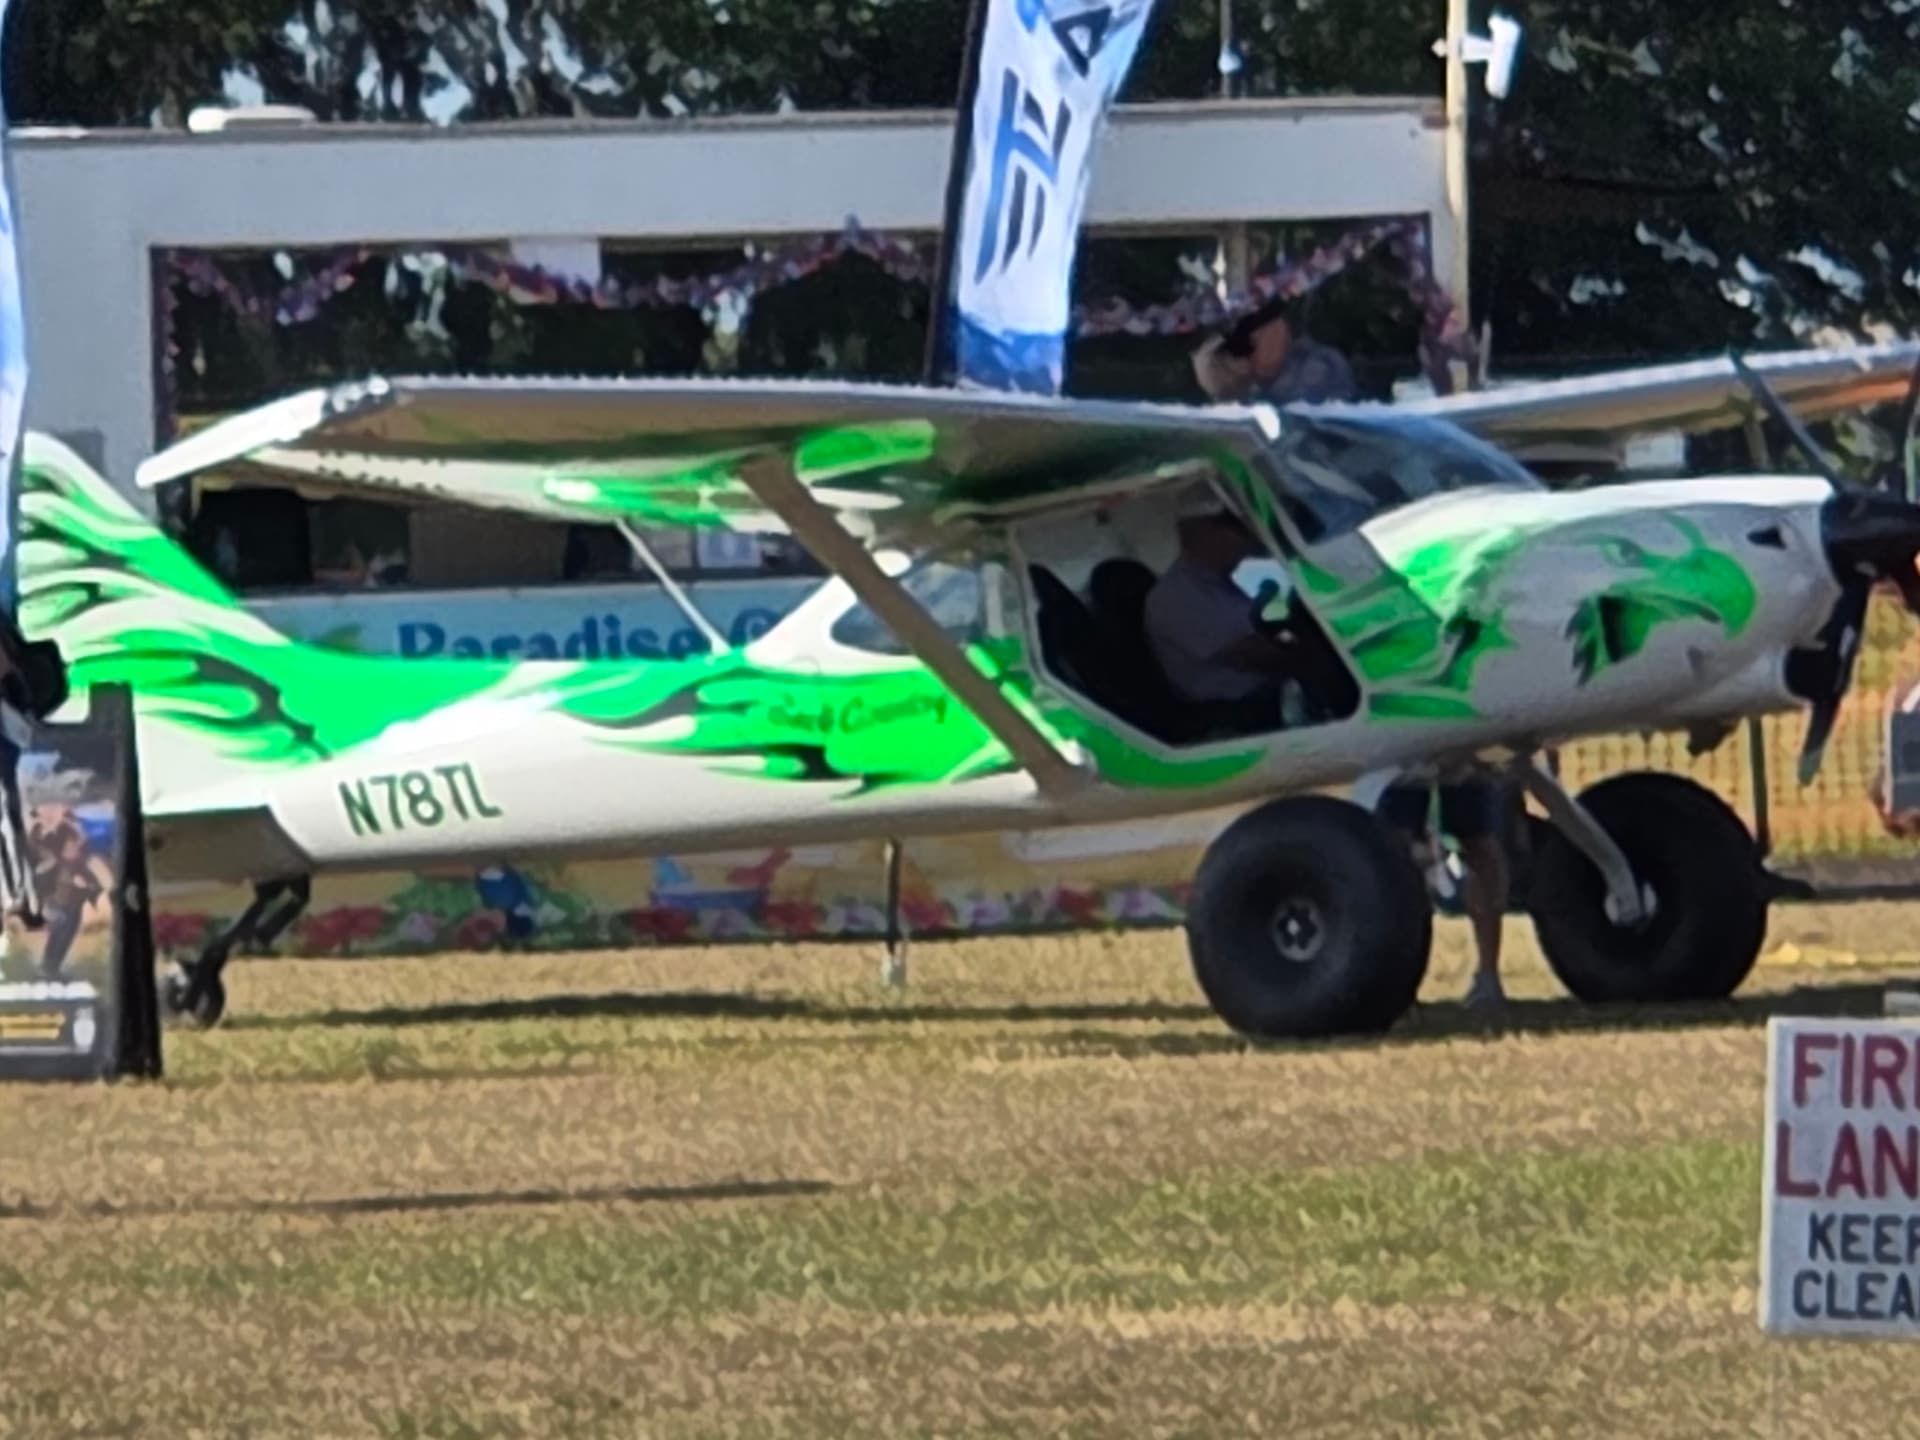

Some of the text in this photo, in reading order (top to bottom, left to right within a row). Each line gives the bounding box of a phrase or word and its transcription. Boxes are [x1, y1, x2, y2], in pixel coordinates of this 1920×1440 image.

[397, 614, 713, 661] Paradise
[338, 761, 503, 836] N78TL
[1793, 1032, 1920, 1112] FIR
[1793, 1269, 1920, 1320] CLEA
